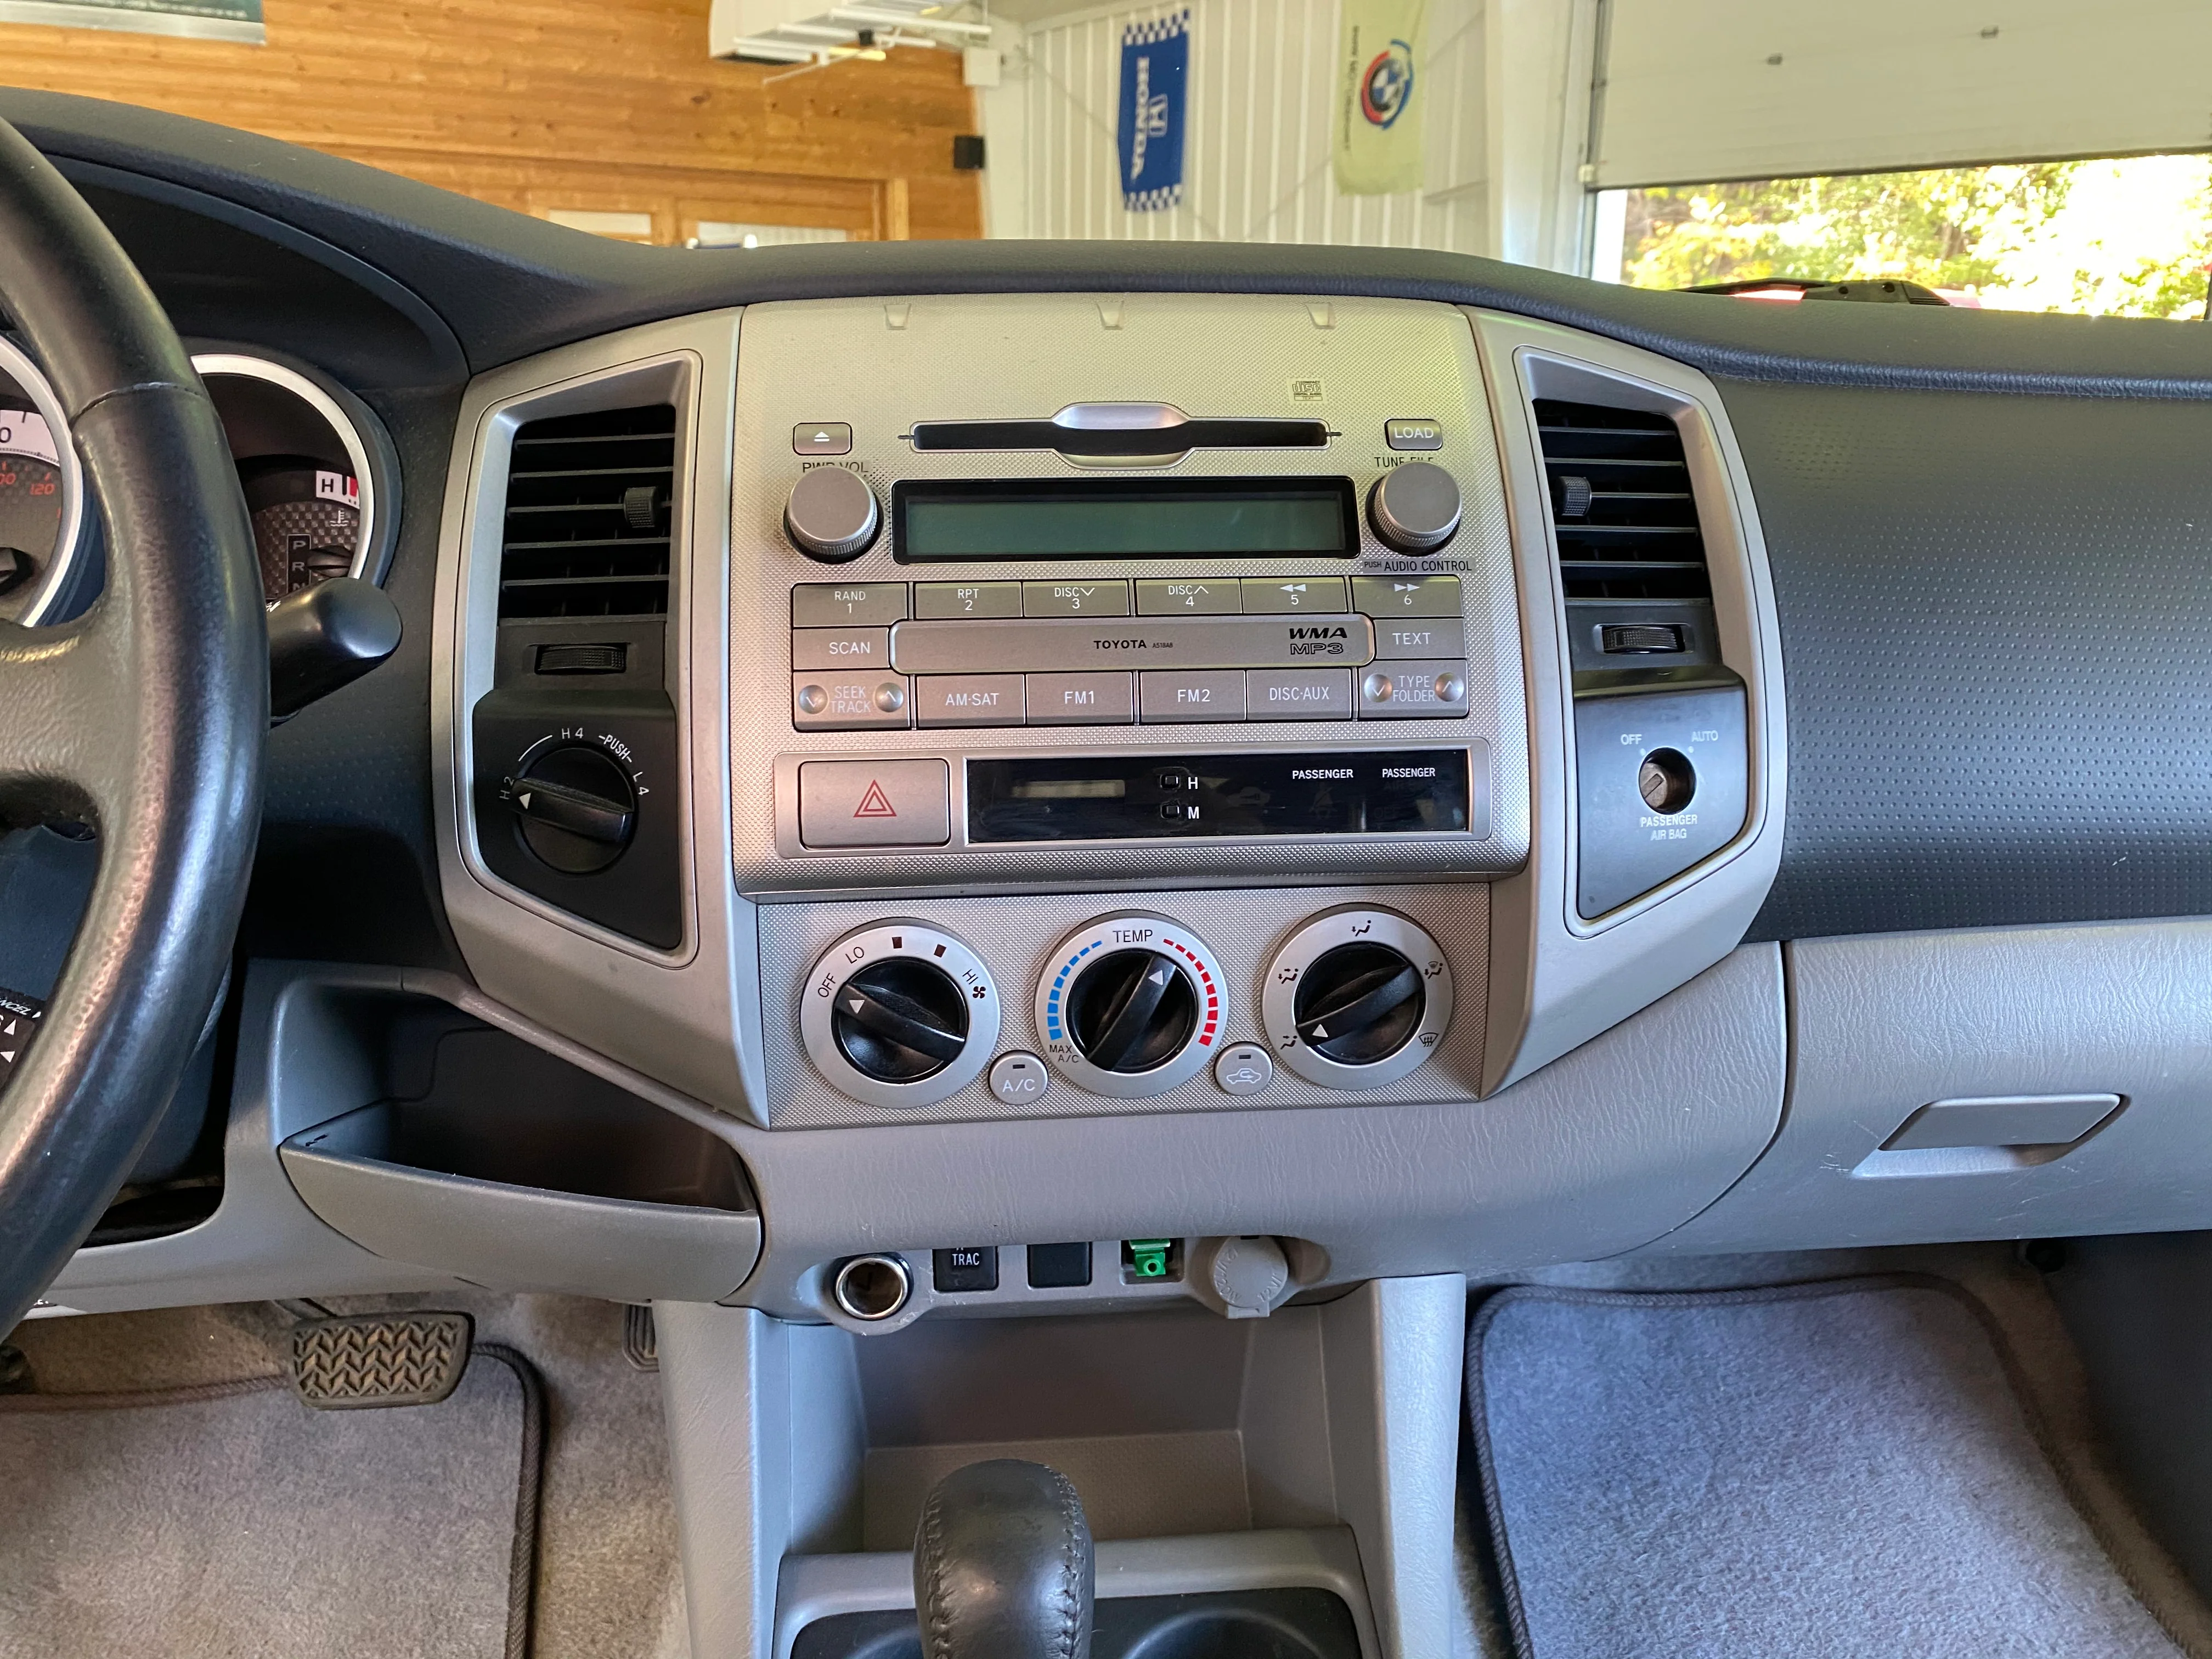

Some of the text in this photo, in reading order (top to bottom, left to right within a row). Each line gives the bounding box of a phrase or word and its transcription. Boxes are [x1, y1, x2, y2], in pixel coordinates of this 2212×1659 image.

[1292, 380, 1322, 392] disc
[1394, 427, 1434, 438] LOAD
[30, 482, 55, 496] 120
[321, 478, 334, 493] H
[292, 540, 307, 550] P
[291, 561, 306, 572] R
[1384, 560, 1417, 572] AUDIO
[1421, 560, 1472, 571] CONTROL
[834, 590, 866, 601] RAND
[957, 588, 979, 599] RPT
[1054, 587, 1079, 598] DISC
[1168, 585, 1192, 595] DISC
[964, 600, 973, 611] 2
[1071, 599, 1080, 610] 3
[1185, 596, 1195, 607] 4
[1291, 594, 1299, 606] 5
[1404, 594, 1412, 606] 6
[847, 604, 852, 614] 1
[1289, 627, 1347, 639] WMA
[1392, 632, 1431, 645] TEXT
[829, 641, 871, 654] SCAN
[1093, 640, 1147, 649] TOYOTA
[1290, 642, 1344, 654] MP3
[1398, 675, 1430, 688] TYPE
[834, 686, 866, 698] SEEK
[1064, 691, 1095, 704] FM1
[1177, 689, 1211, 702] FM2
[1392, 689, 1435, 702] FOLDER
[831, 701, 871, 713] TRACK
[1620, 733, 1642, 745] OFF
[1691, 730, 1719, 742] AUTO
[1291, 768, 1354, 780] PASSENGER
[1381, 767, 1436, 778] PASSENGER
[1188, 777, 1198, 789] H
[1187, 807, 1200, 819] M
[1640, 814, 1698, 828] PASSENGER
[1650, 828, 1687, 841] AIR BAG
[1112, 929, 1153, 943] TEMP
[845, 946, 865, 964] LO
[962, 968, 979, 985] HI
[817, 973, 836, 998] OFF
[1049, 1044, 1073, 1054] MAX
[1058, 1054, 1079, 1063] A/C
[1002, 1079, 1036, 1093] A/C
[952, 1252, 980, 1266] TRAC
